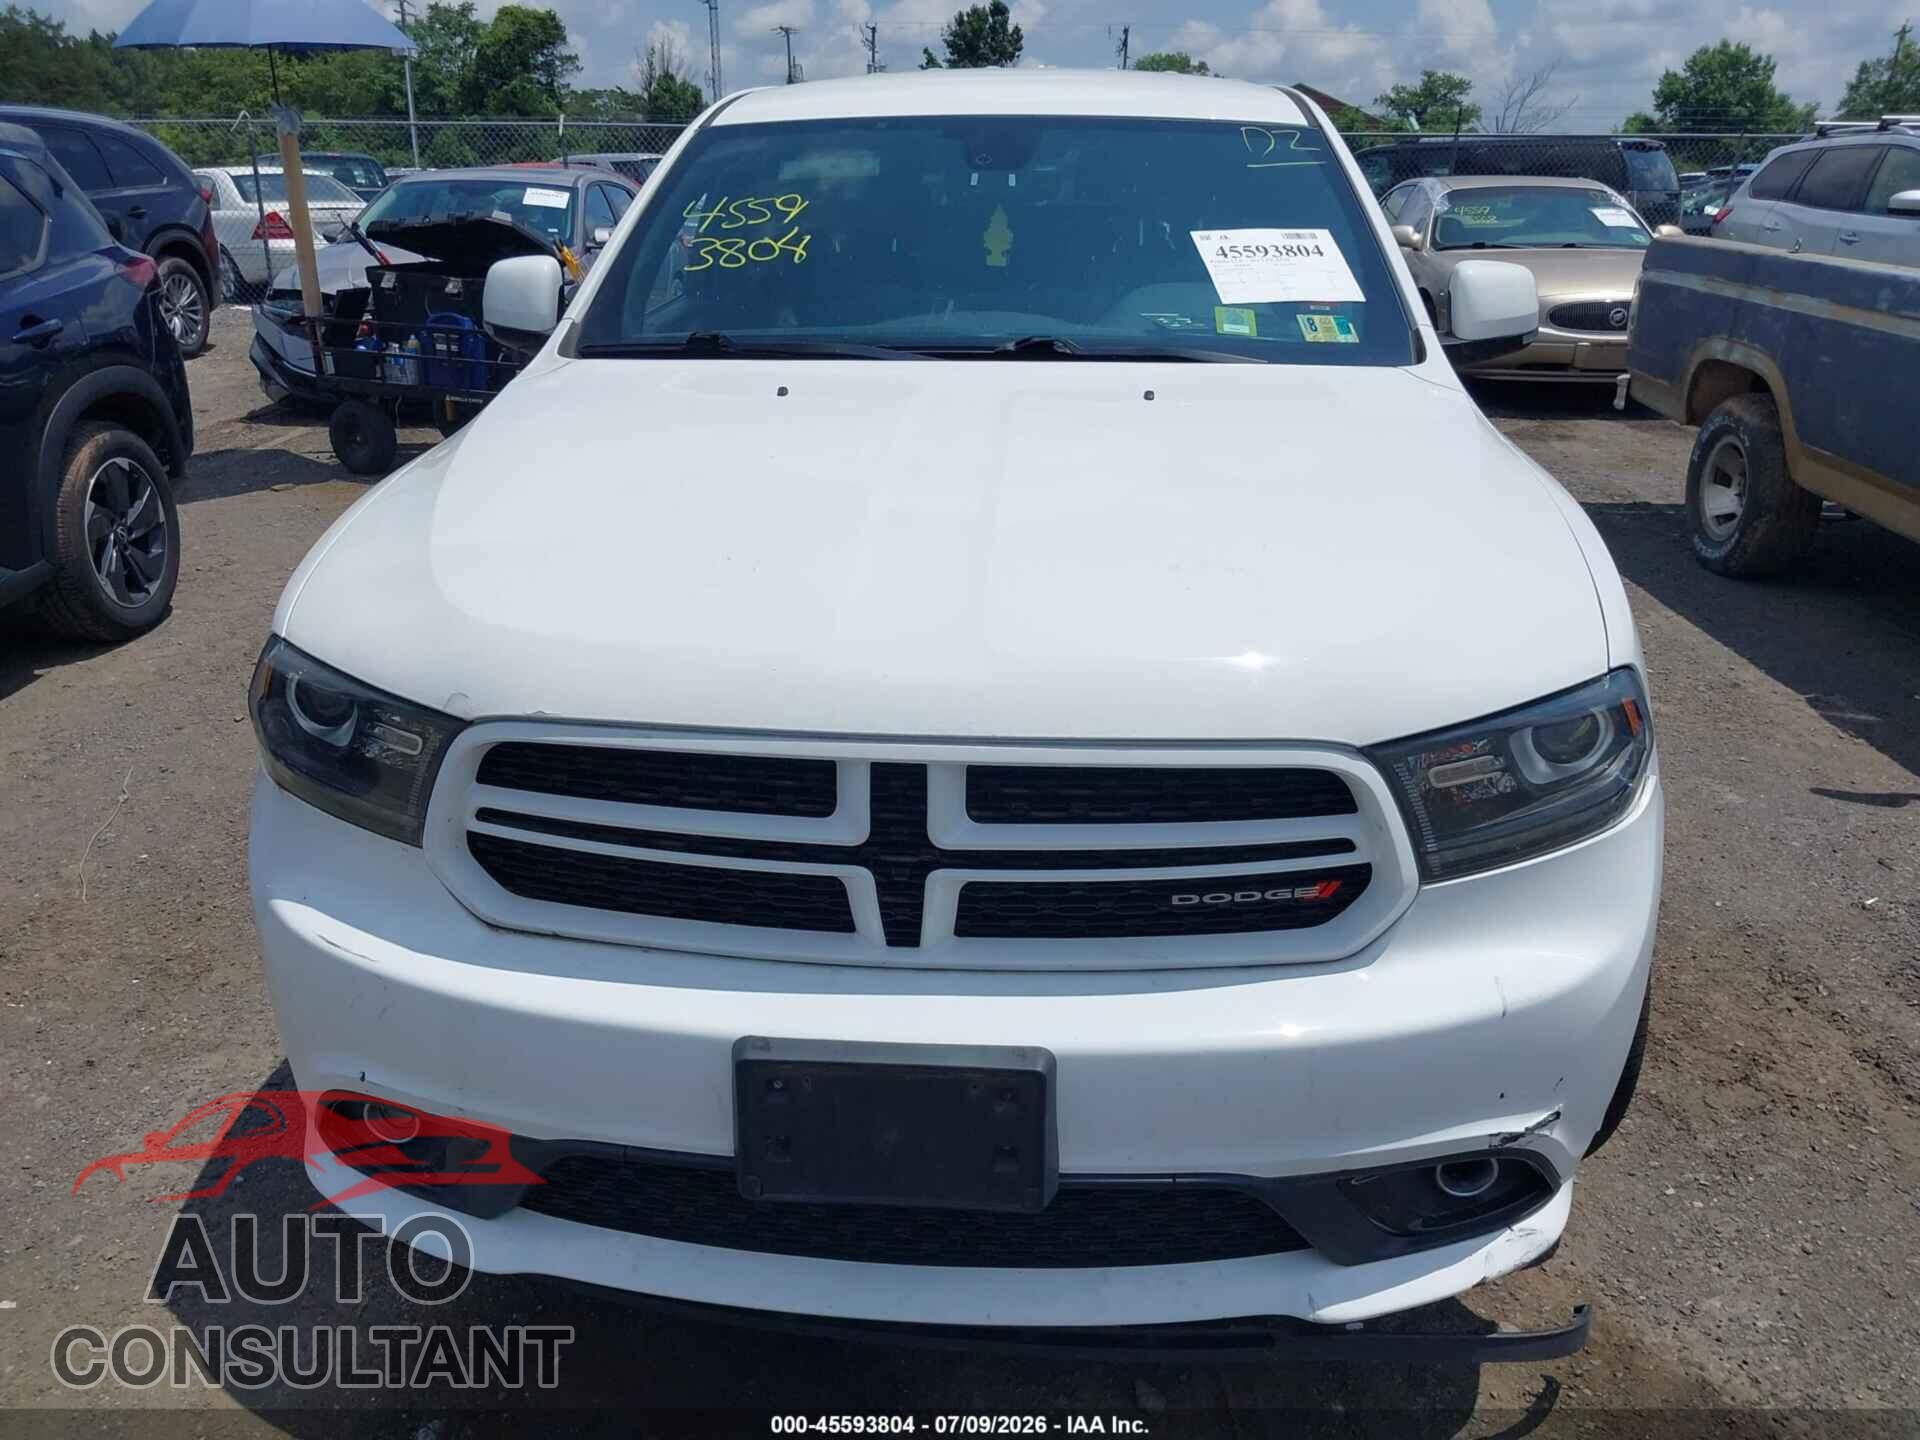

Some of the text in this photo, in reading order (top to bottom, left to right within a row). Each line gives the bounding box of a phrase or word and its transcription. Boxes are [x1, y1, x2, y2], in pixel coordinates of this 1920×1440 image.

[682, 194, 809, 232] 4559
[684, 227, 811, 271] 3804
[1216, 244, 1326, 259] 45593804
[1172, 886, 1320, 905] DODGE
